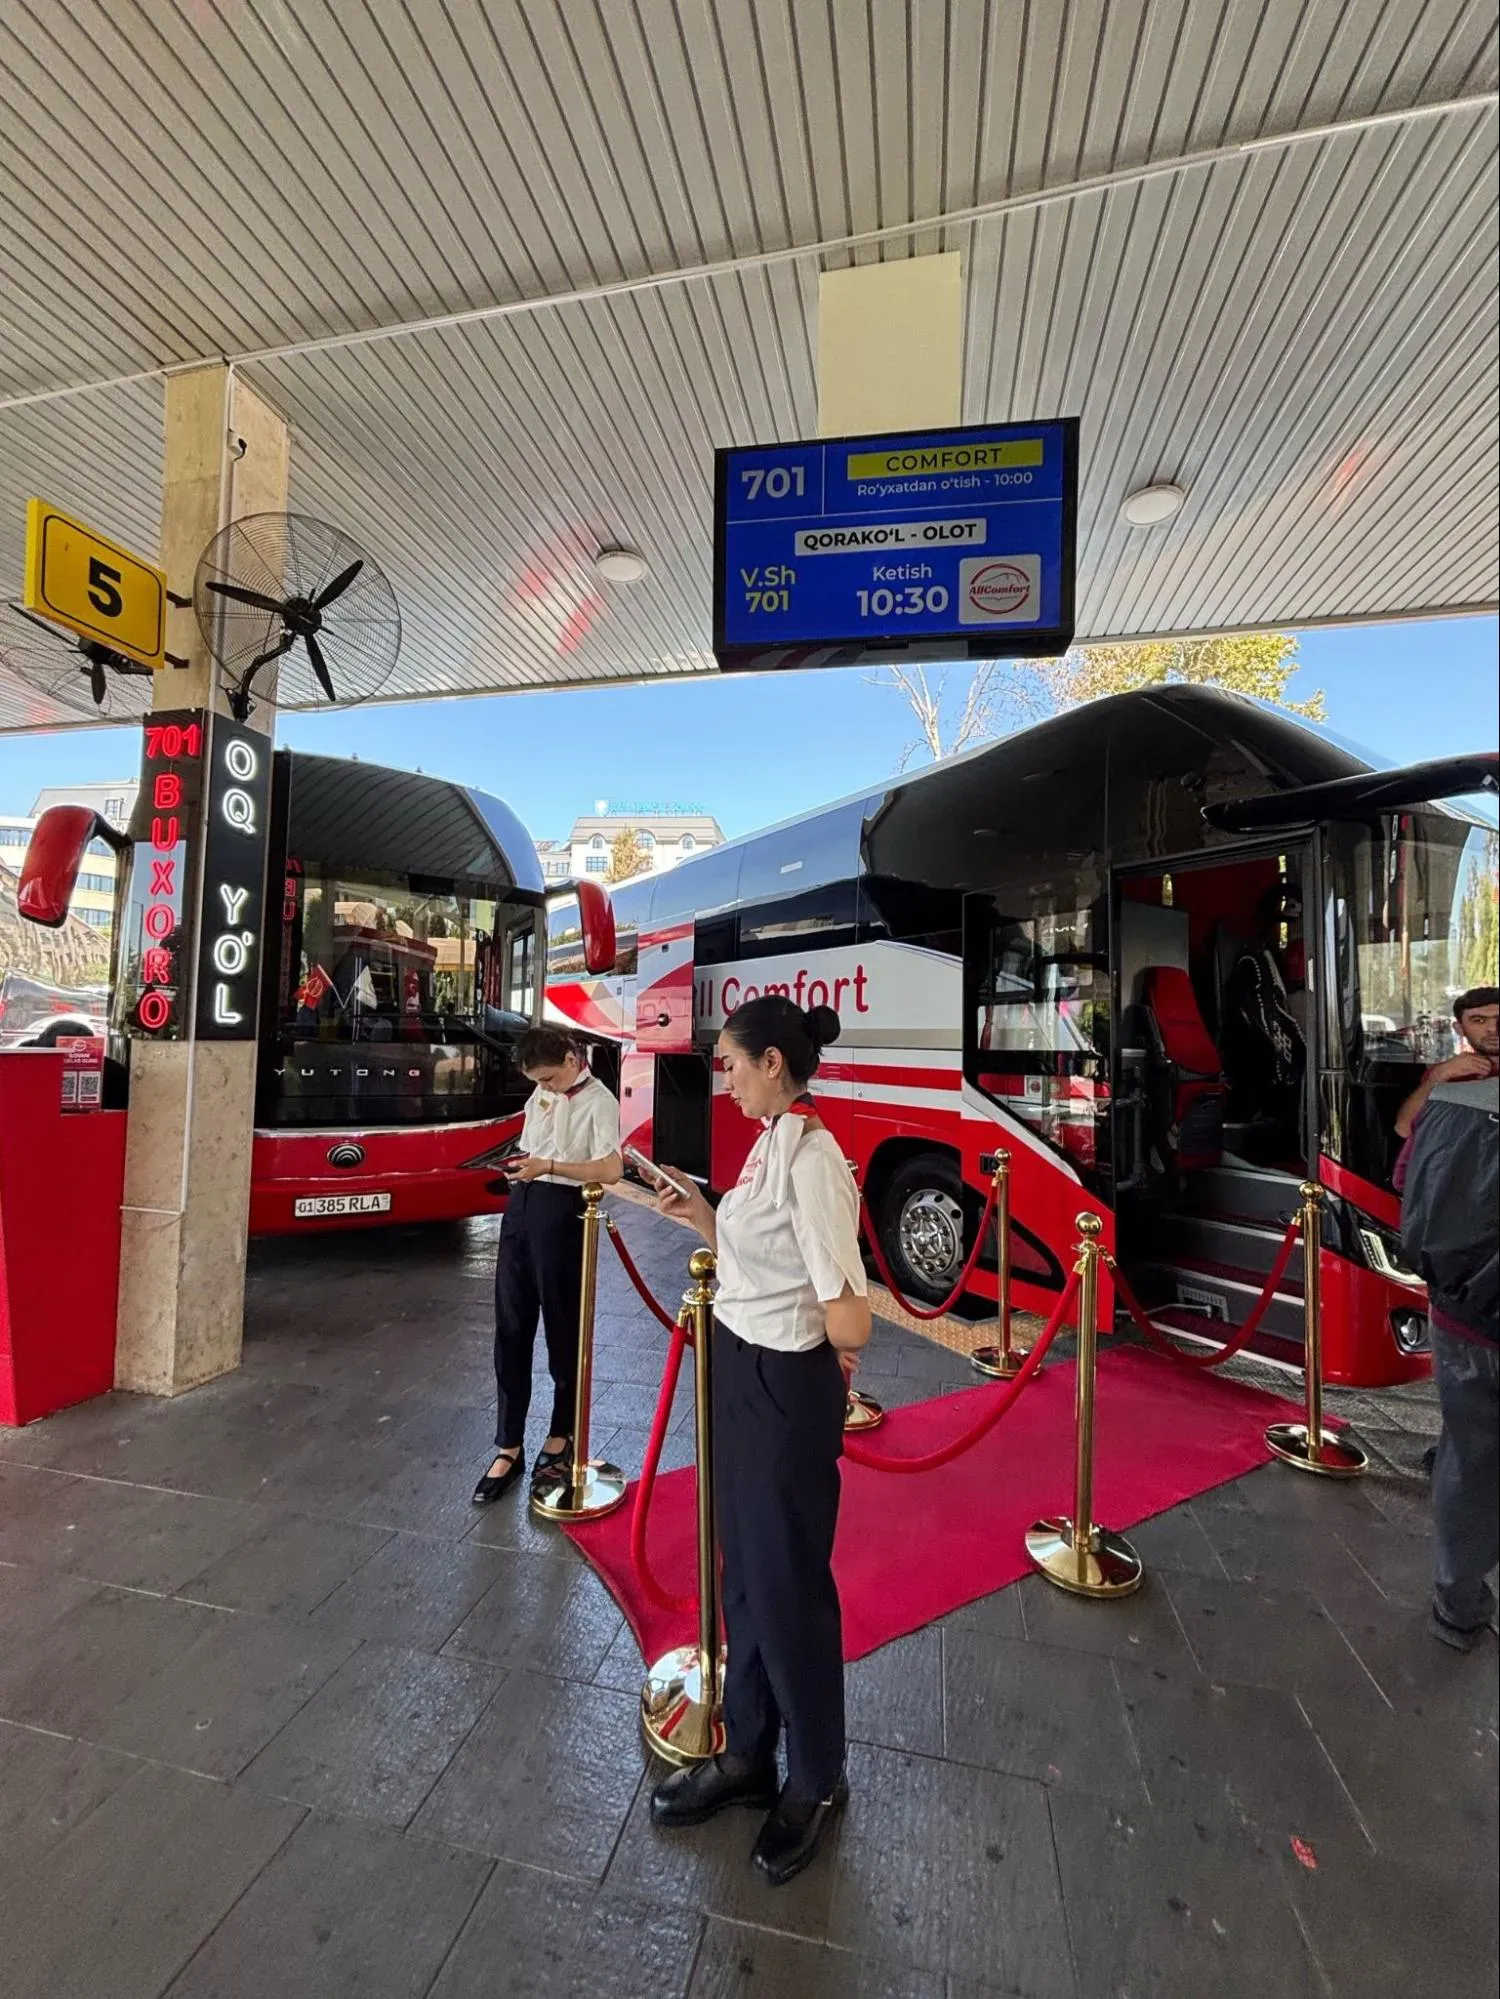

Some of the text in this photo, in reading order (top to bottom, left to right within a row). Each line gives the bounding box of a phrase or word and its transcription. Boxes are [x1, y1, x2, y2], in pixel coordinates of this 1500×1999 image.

[886, 448, 1003, 472] COMFORT
[742, 467, 804, 499] 701
[995, 471, 1033, 486] 10:00
[922, 524, 977, 541] OLOT
[740, 565, 796, 588] V.Sh
[873, 565, 932, 582] Ketish
[87, 557, 123, 618] 5
[969, 584, 1031, 596] AllComfort
[745, 591, 789, 613] 701
[856, 586, 949, 616] 10:30
[145, 723, 200, 759] 701
[222, 740, 256, 834] OQ
[139, 774, 184, 1029] BUXORO
[273, 1068, 420, 1077] YUTONG
